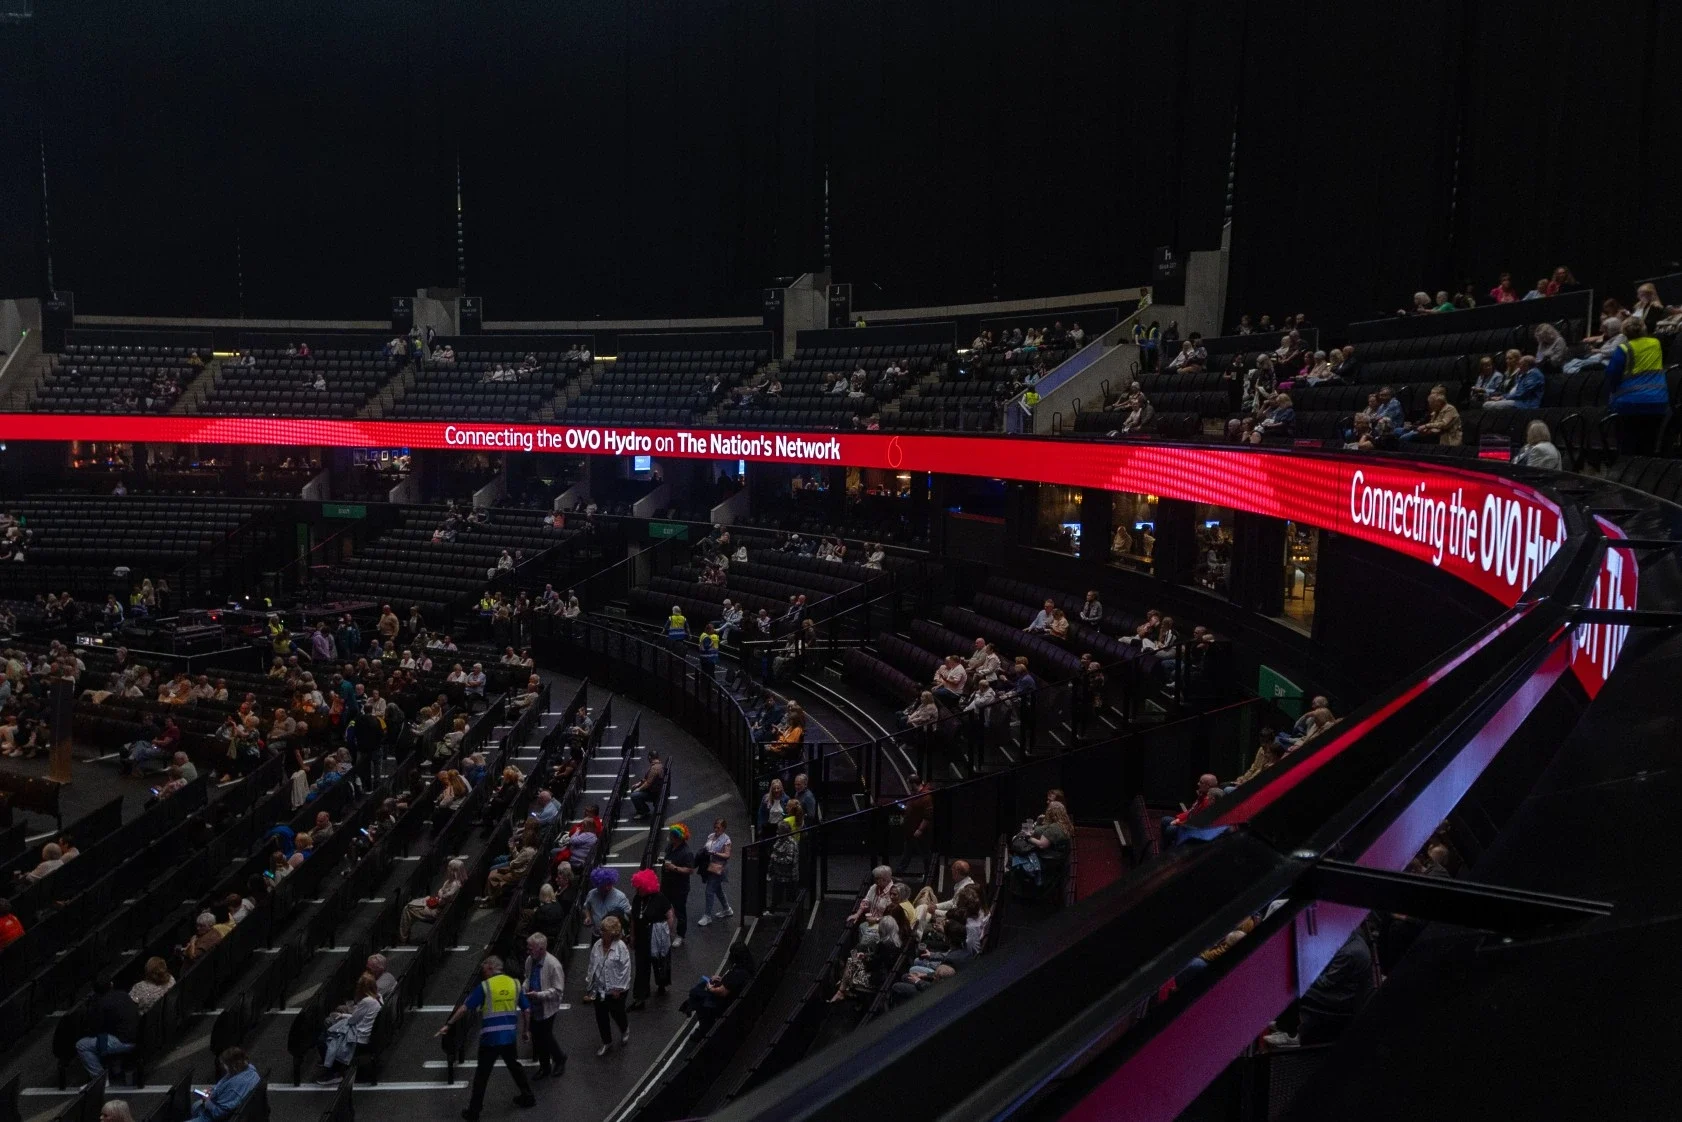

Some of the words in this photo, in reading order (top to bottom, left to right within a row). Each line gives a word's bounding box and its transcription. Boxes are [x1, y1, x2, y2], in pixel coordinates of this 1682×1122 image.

[398, 299, 405, 307] K
[466, 299, 472, 307] K
[445, 425, 533, 451] Connecting
[537, 428, 562, 448] the
[565, 429, 601, 450] OVO
[605, 430, 651, 455] Hydro
[655, 436, 674, 452] on
[677, 432, 707, 454] The
[710, 433, 773, 457] Nation's
[775, 435, 841, 460] Network
[1350, 470, 1446, 567] Connecting
[1450, 488, 1477, 563] the
[1480, 493, 1522, 586] OVO
